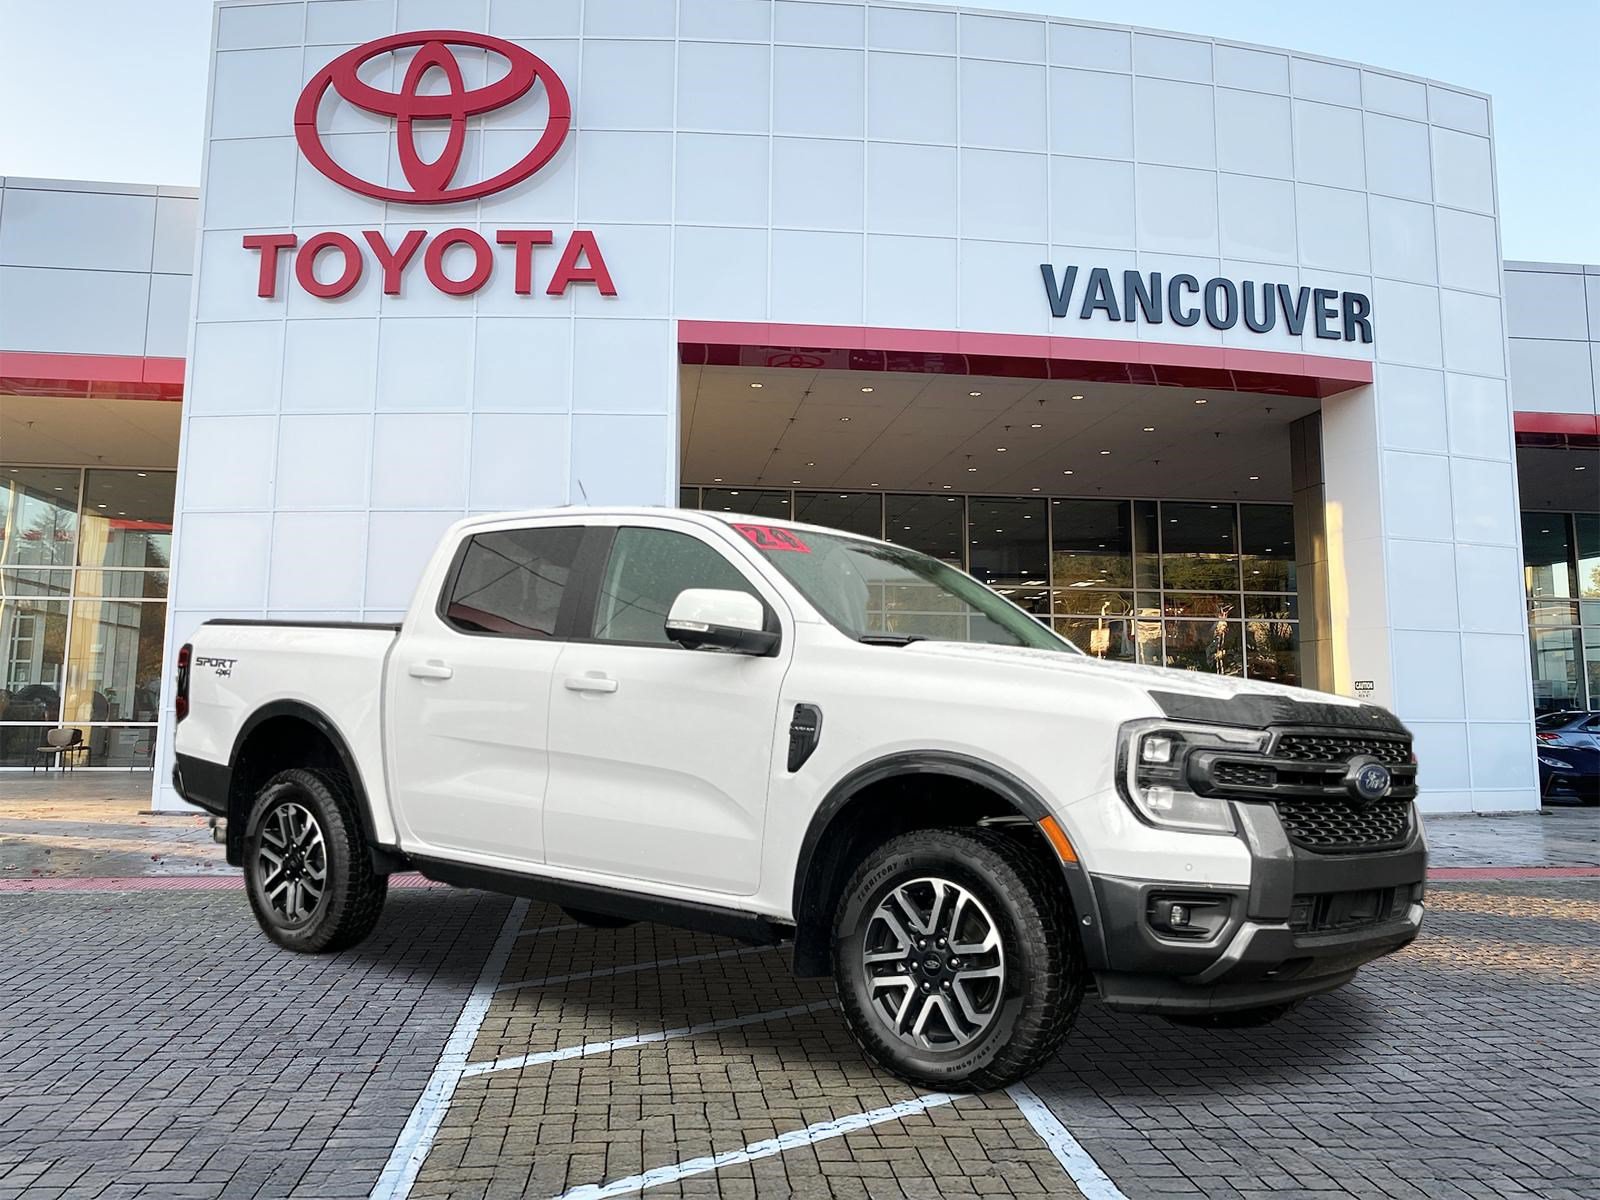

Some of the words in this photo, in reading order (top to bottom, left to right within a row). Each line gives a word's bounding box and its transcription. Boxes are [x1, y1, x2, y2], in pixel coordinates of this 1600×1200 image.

[243, 228, 618, 298] TOYOTA
[1040, 264, 1373, 343] VANCOUVER
[195, 656, 238, 668] SPORT
